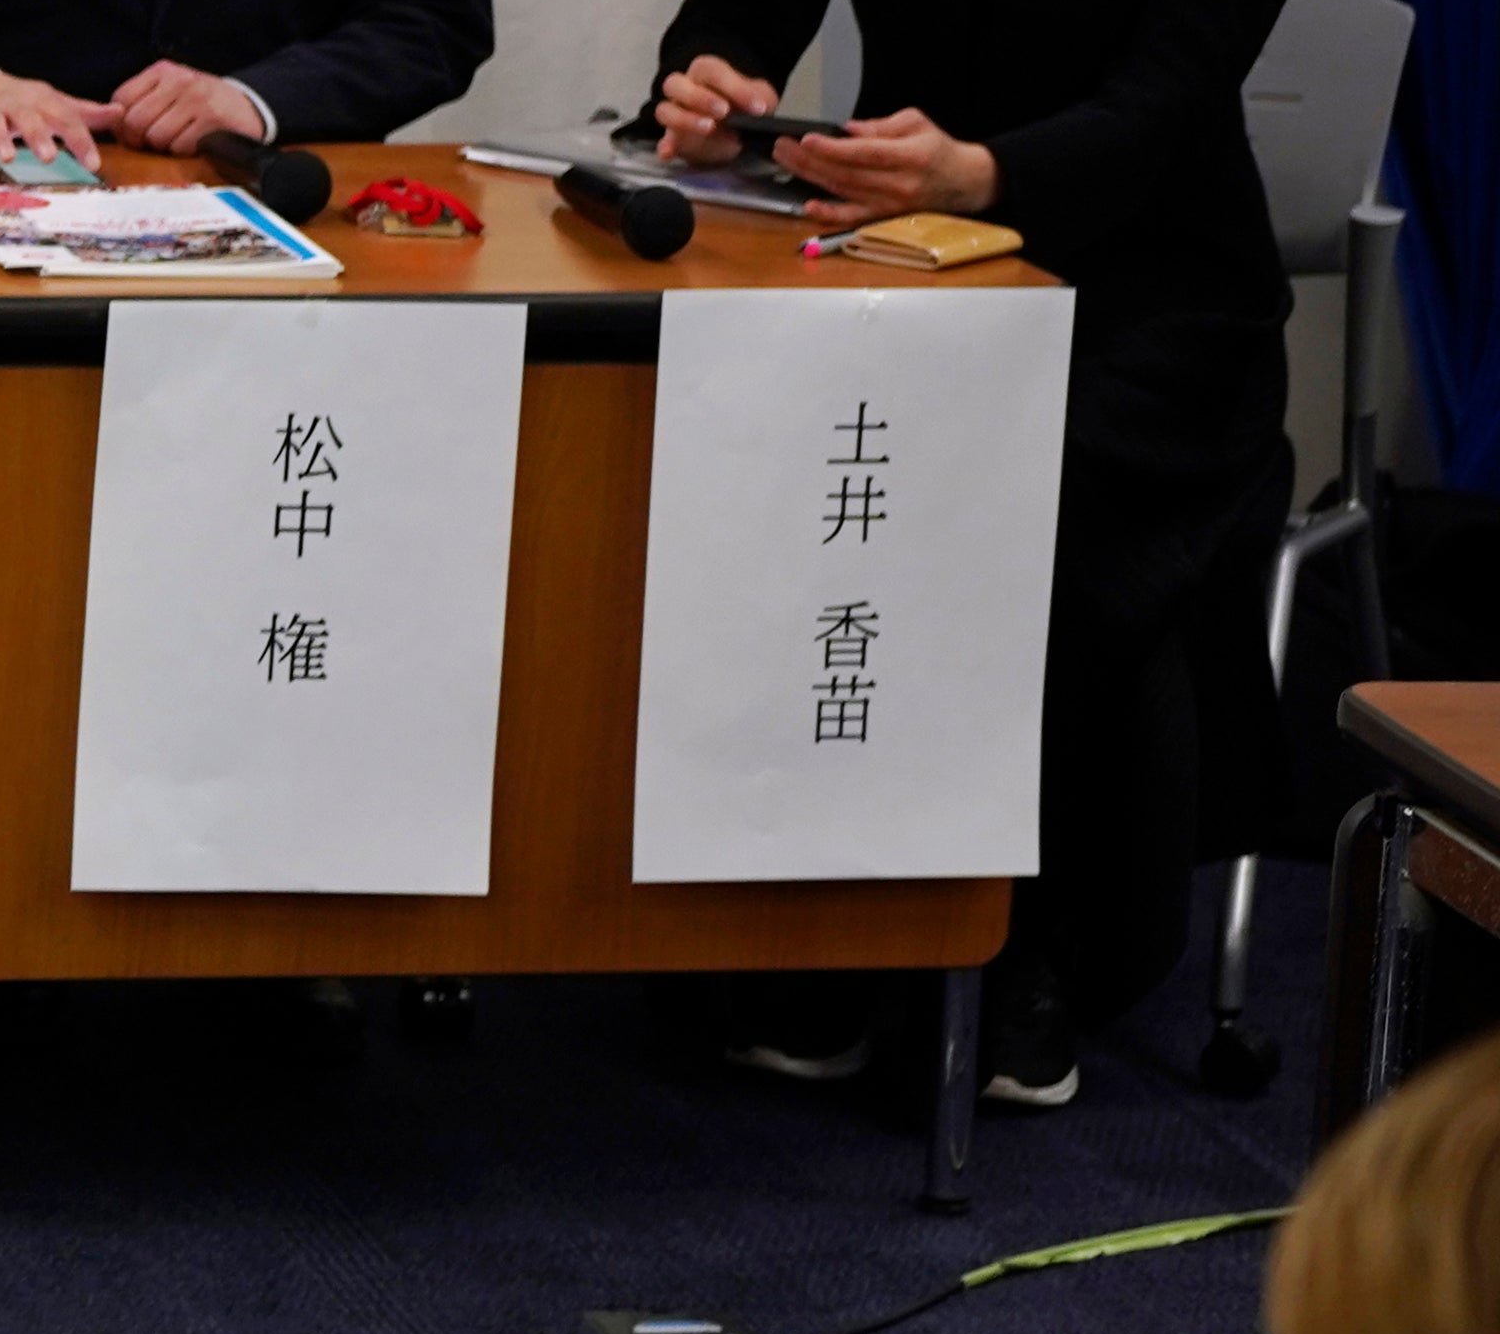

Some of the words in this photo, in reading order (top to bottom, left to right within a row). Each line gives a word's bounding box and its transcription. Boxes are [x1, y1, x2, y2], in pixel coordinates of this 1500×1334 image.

[272, 412, 343, 558] 松中
[822, 401, 890, 545] 土井
[257, 613, 329, 684] 権
[812, 600, 879, 744] 香苗
